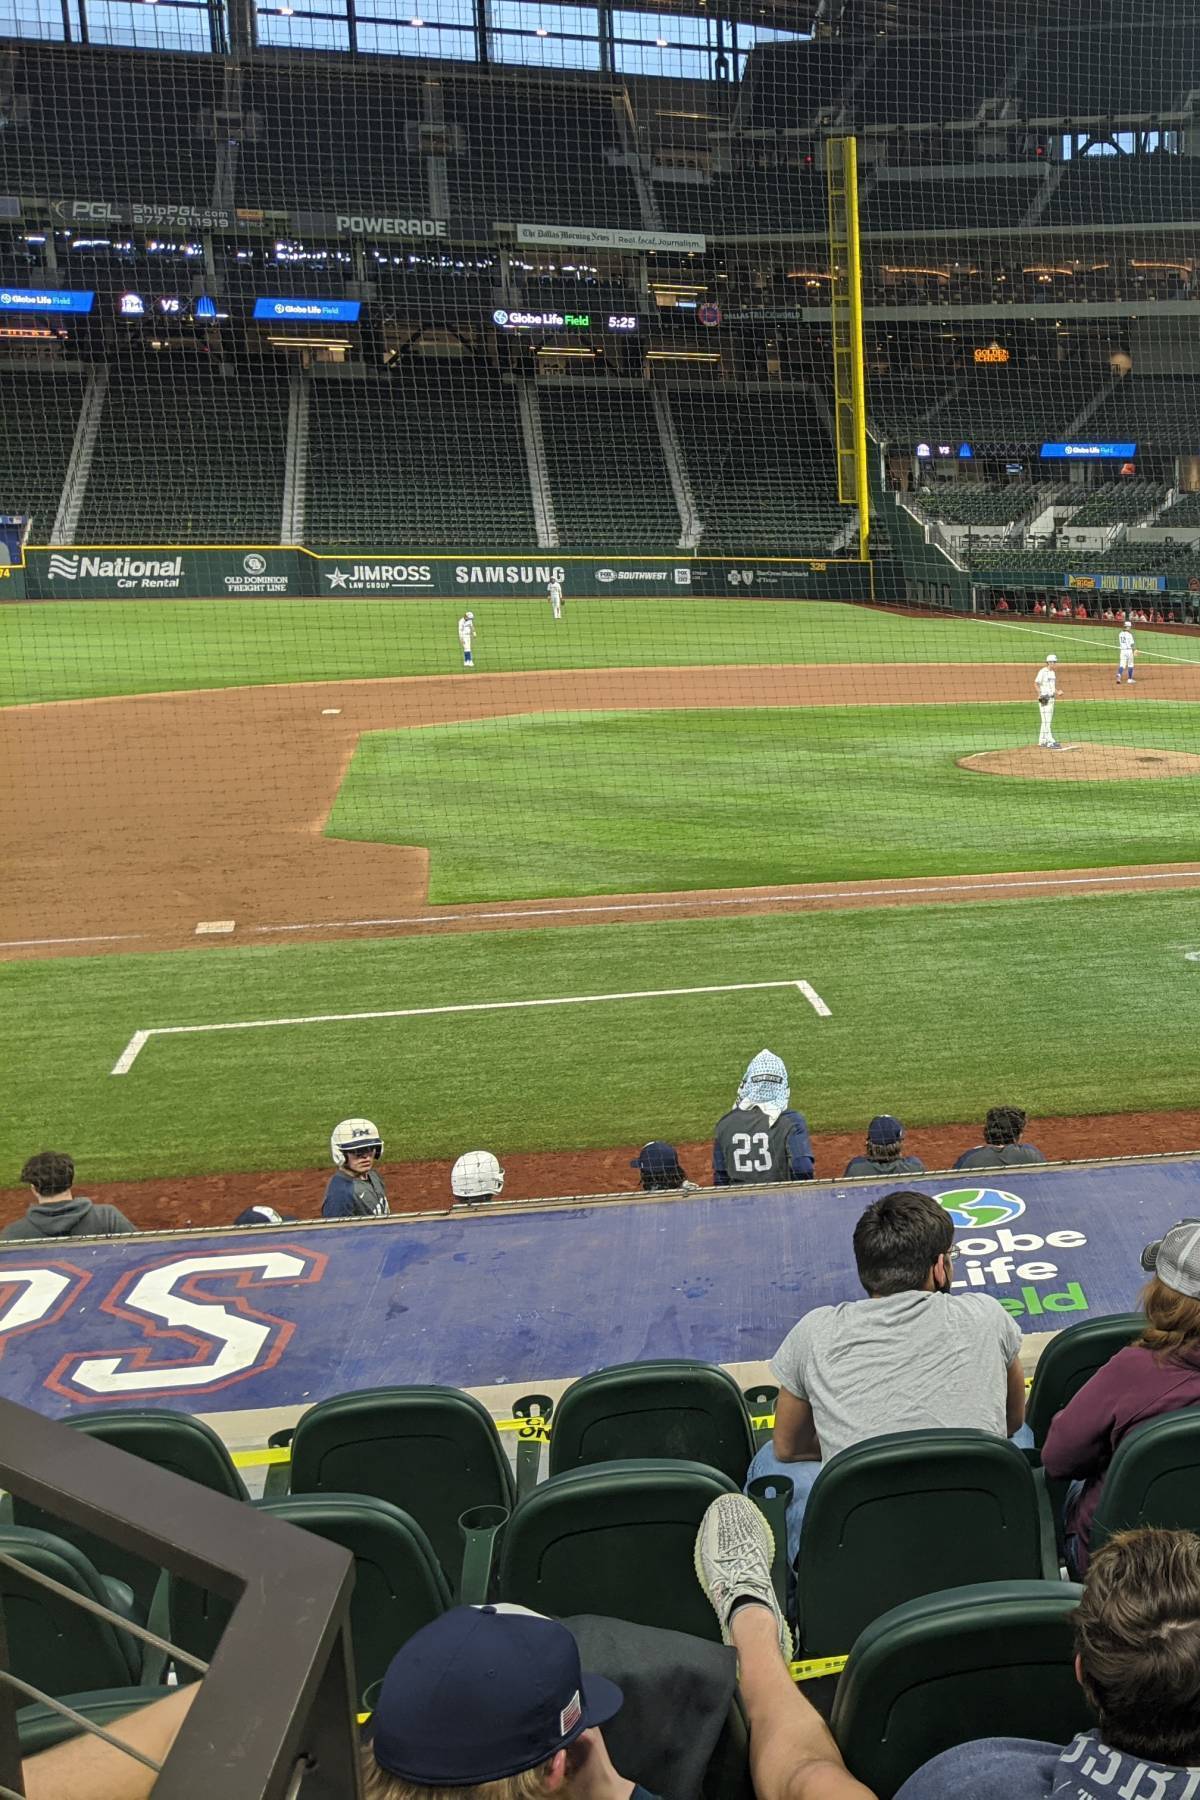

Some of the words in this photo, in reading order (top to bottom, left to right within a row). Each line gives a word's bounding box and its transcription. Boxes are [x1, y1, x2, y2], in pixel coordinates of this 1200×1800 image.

[72, 201, 122, 219] PGL
[132, 204, 228, 218] ShipPGL.com
[336, 216, 447, 237] POWERADE
[592, 232, 610, 242] News
[12, 295, 36, 304] Globe
[36, 295, 52, 305] Life
[285, 305, 307, 314] Globe
[307, 306, 322, 315] Life
[509, 312, 542, 325] Globe
[542, 313, 563, 326] Life
[564, 314, 590, 327] Field
[608, 316, 636, 328] 5:25
[809, 562, 826, 571] 326
[225, 576, 243, 584] OLD
[244, 576, 288, 584] DOMINION
[456, 566, 565, 583] SAMSUNG
[618, 571, 667, 580] SOUTHWEST
[117, 578, 138, 588] Car
[141, 578, 179, 588] Rental
[228, 584, 266, 592] FREIGHT
[267, 584, 287, 592] LINE
[732, 1132, 773, 1172] 23
[951, 1229, 1088, 1256] obe
[990, 1281, 1089, 1317] eld
